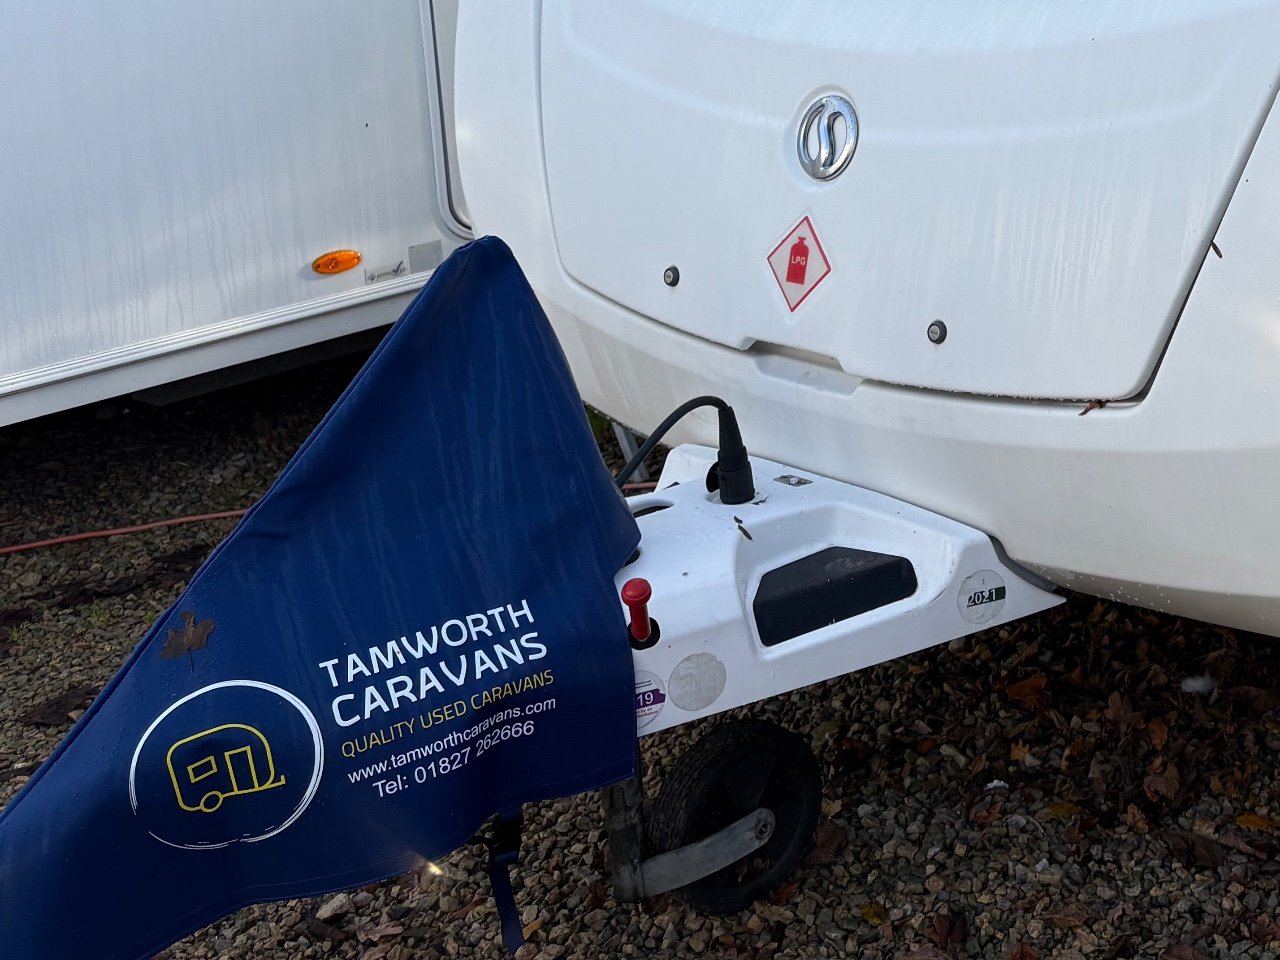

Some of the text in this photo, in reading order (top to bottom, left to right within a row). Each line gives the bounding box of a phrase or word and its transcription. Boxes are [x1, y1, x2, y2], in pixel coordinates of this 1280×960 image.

[791, 256, 806, 266] LPG
[968, 589, 996, 605] 2021
[319, 599, 535, 688] TAMWORTH
[331, 631, 548, 727] CARAVANS
[341, 669, 554, 758] QUALITY USED CARAVANS
[348, 698, 556, 784] www.tamworthcaravans.com
[372, 720, 535, 798] Tel: 01827 262666
